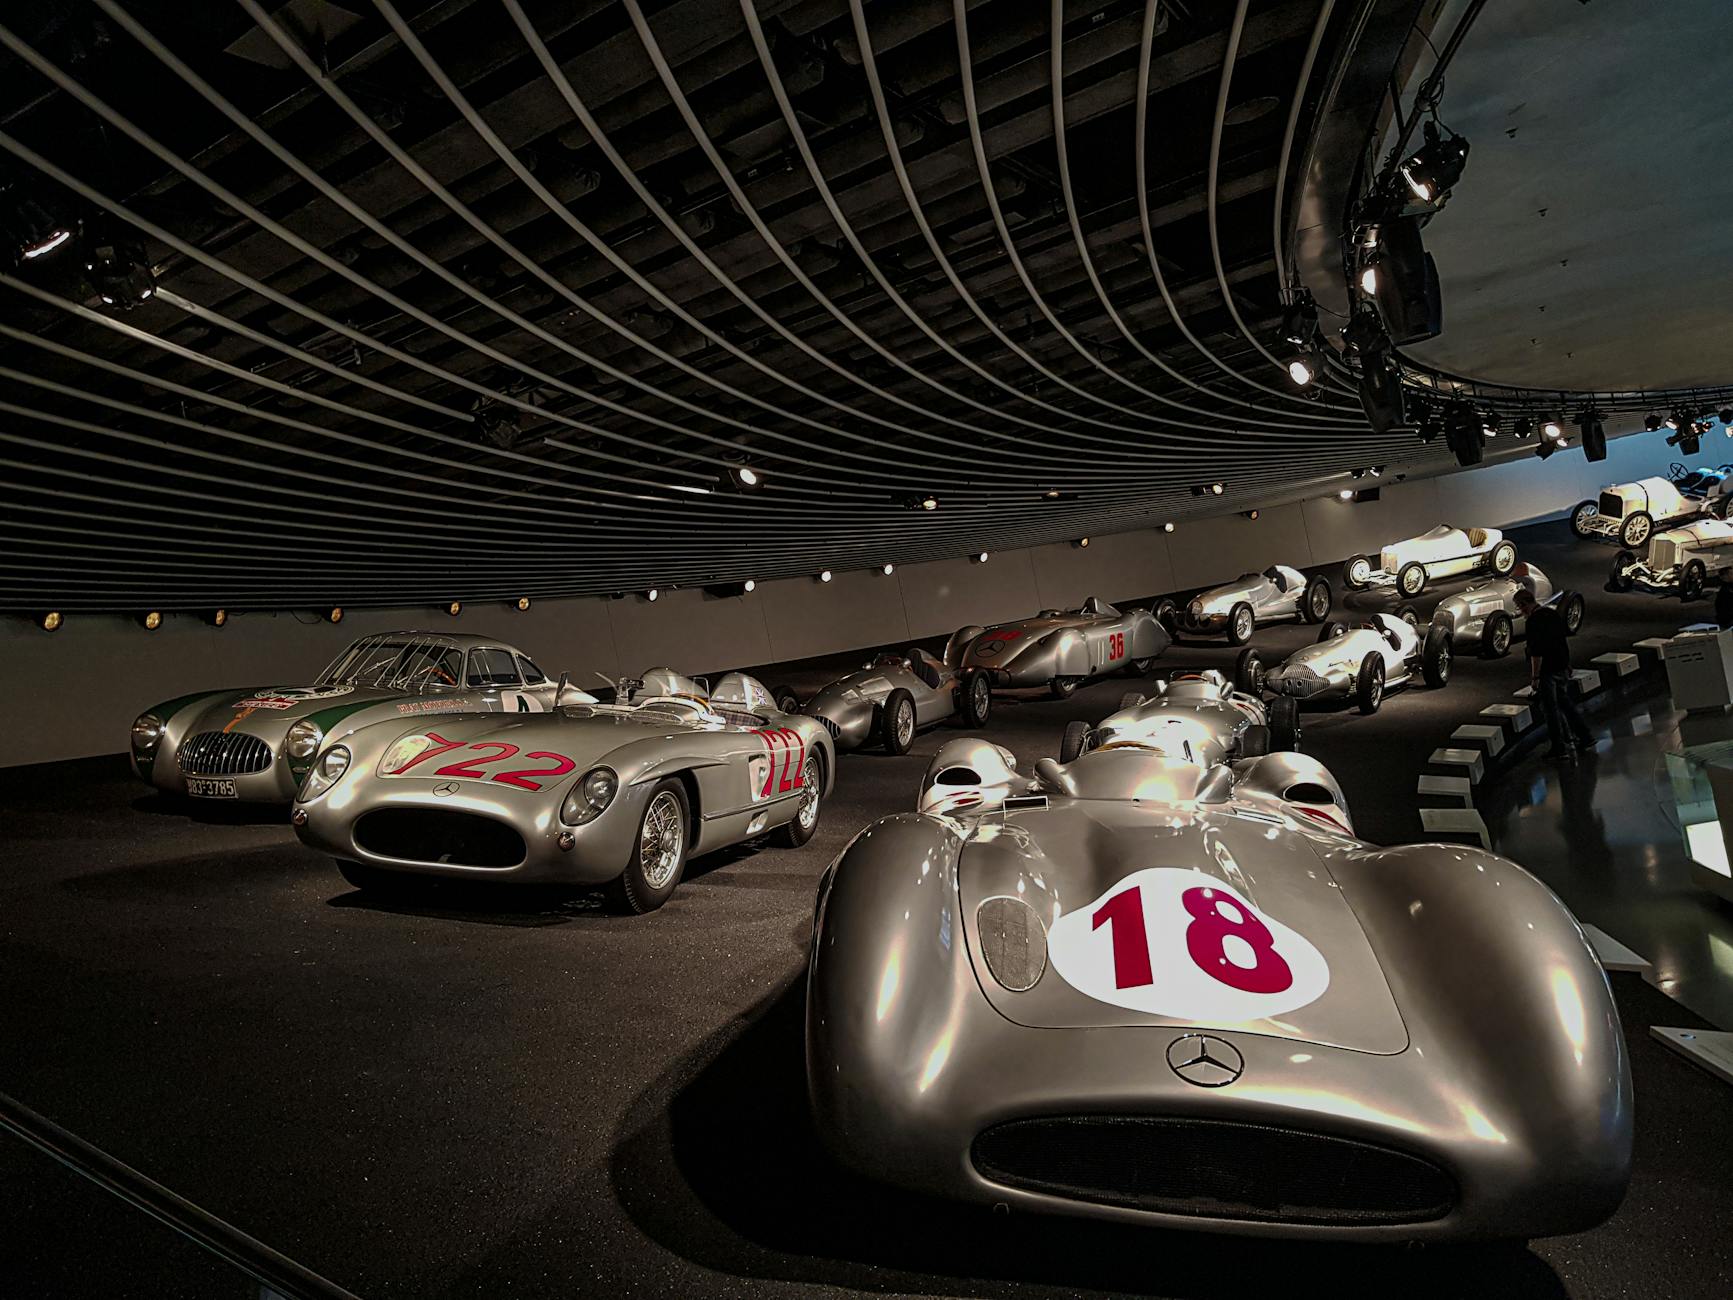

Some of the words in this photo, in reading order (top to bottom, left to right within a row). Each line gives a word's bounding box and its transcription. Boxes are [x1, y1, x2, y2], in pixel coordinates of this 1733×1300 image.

[1109, 632, 1124, 660] 36
[389, 732, 576, 791] 722
[750, 727, 805, 797] 722
[1092, 885, 1293, 994] 18
